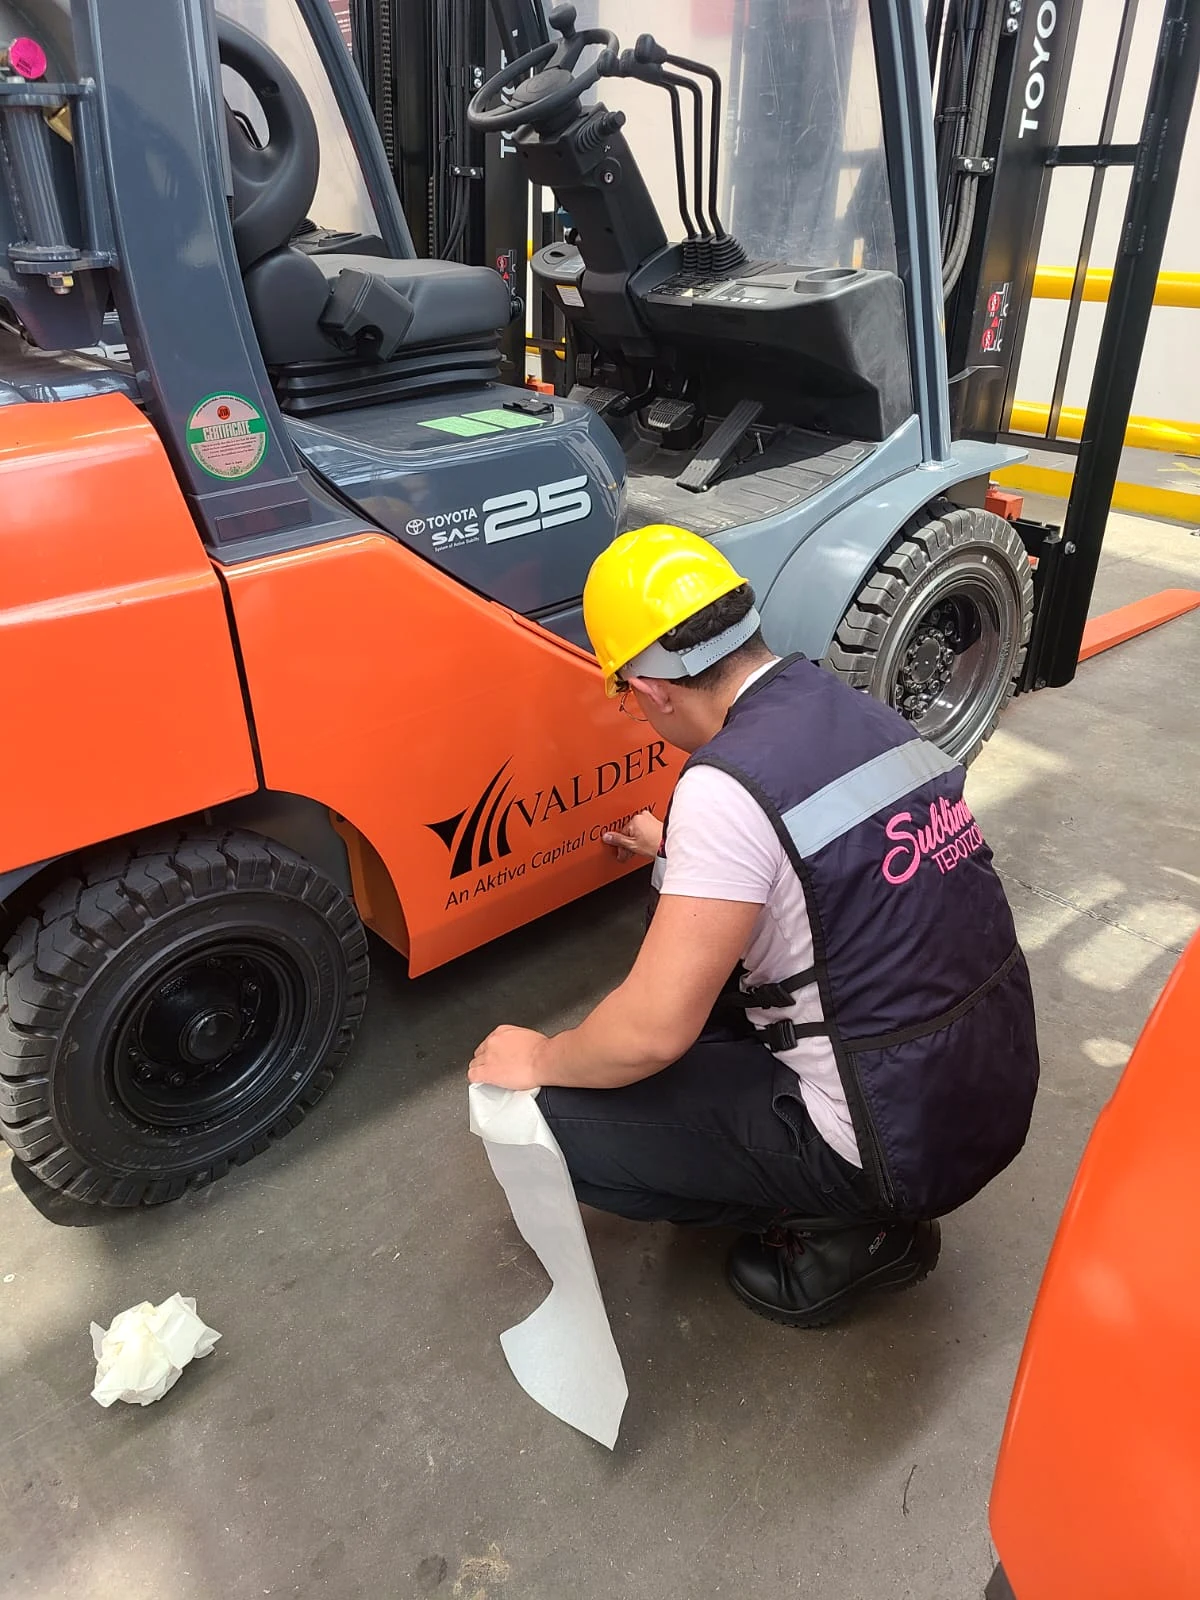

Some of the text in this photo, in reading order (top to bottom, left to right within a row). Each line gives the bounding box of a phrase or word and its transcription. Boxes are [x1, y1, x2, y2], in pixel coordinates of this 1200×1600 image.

[203, 420, 251, 441] CERTIFICATE
[426, 507, 478, 530] TOYOTA
[482, 474, 592, 545] 25
[431, 522, 480, 547] SAS
[513, 740, 669, 828] VALDER
[445, 888, 469, 911] An
[473, 863, 526, 897] Aktiva
[531, 831, 586, 869] Capital
